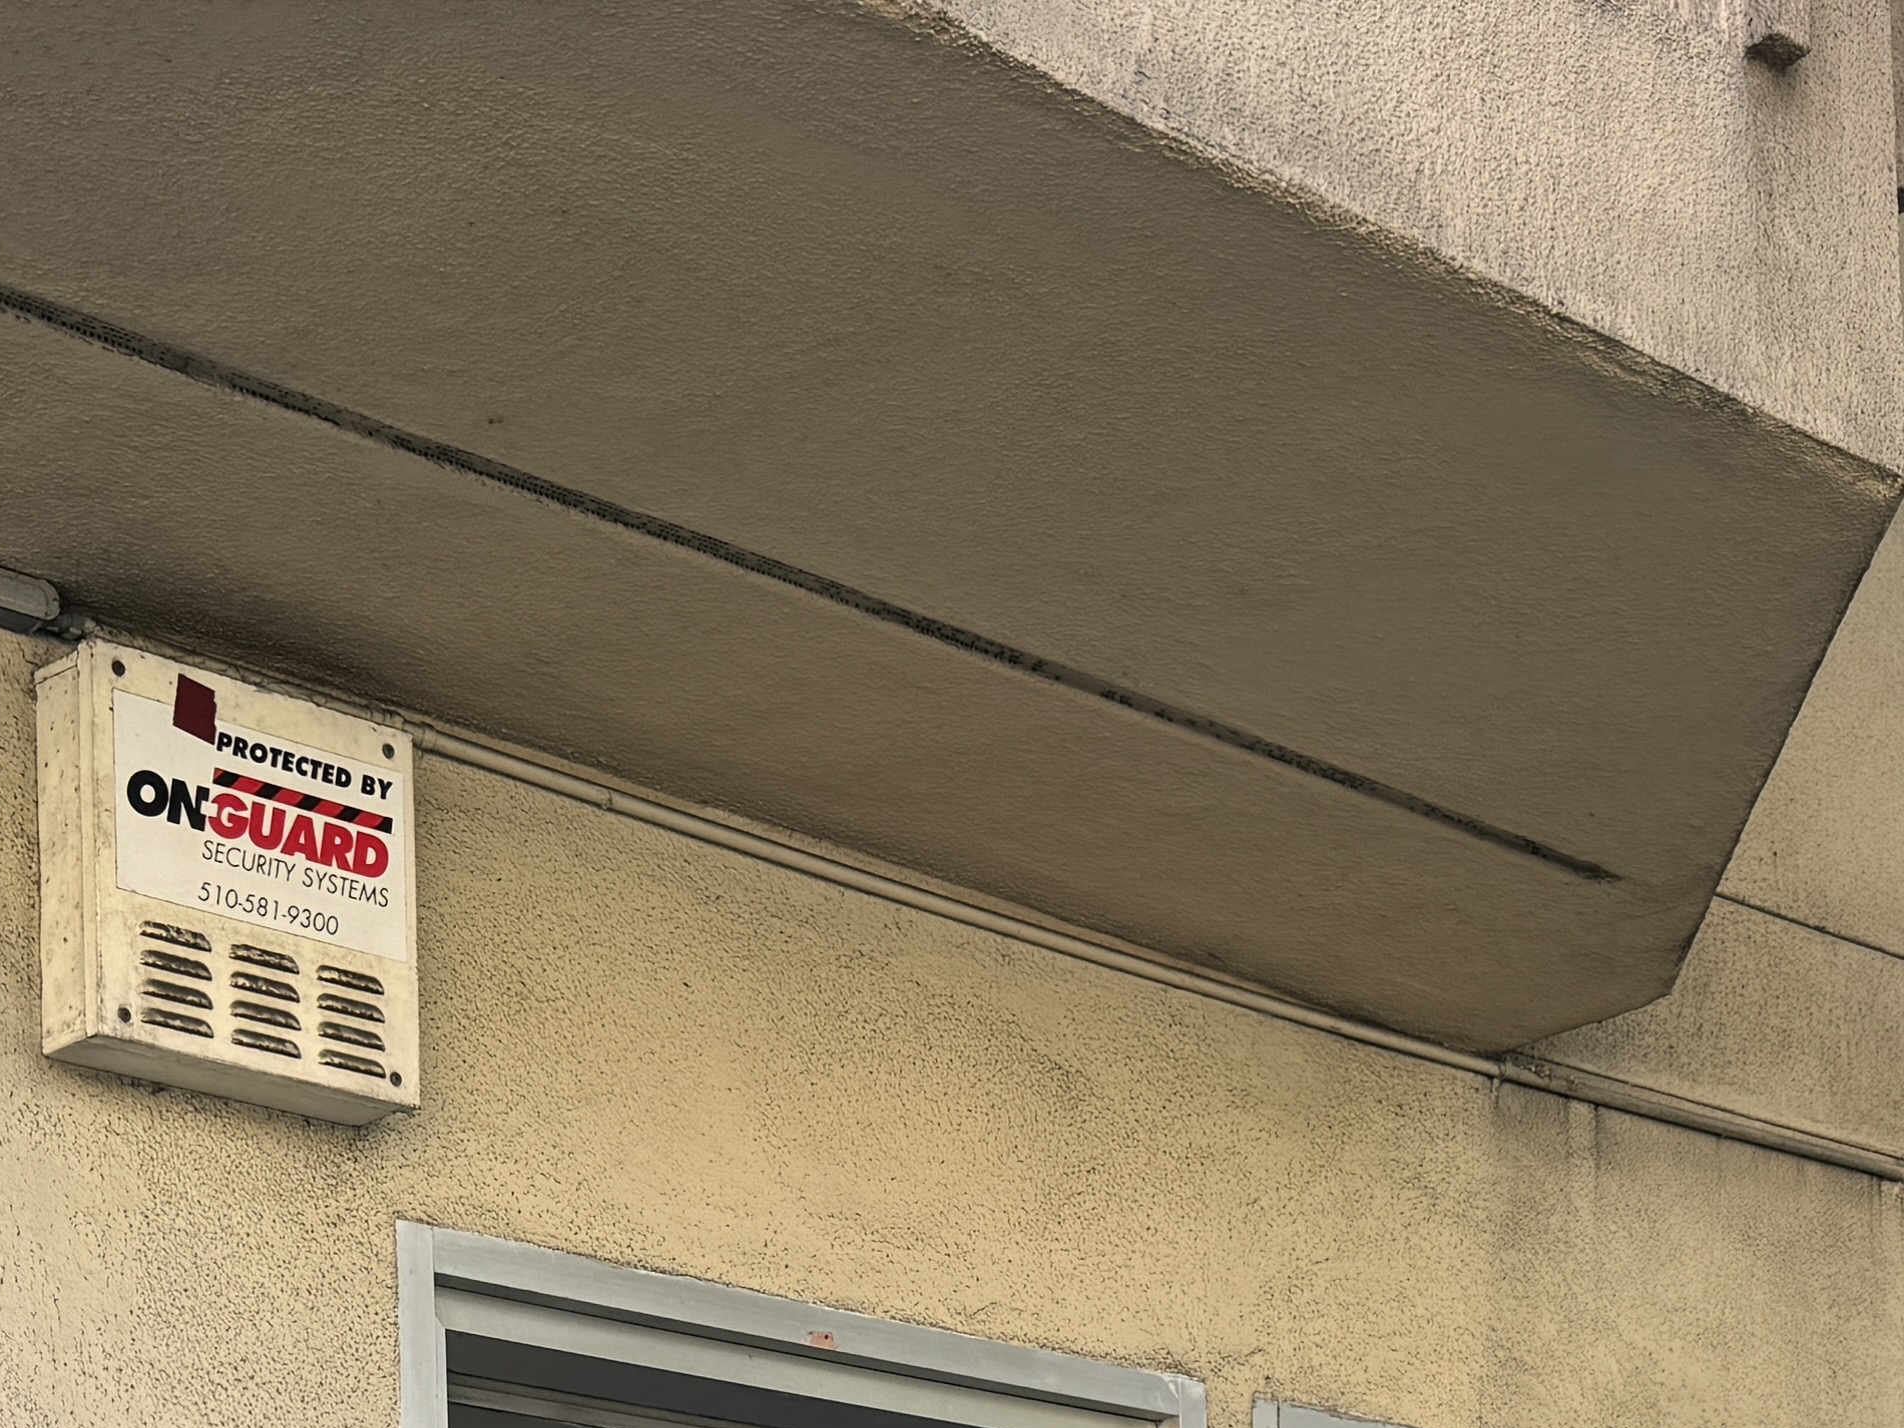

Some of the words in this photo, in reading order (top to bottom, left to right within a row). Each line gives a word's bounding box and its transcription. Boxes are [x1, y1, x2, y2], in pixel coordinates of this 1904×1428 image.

[216, 732, 352, 788] PROTECTED
[360, 774, 393, 800] BY
[202, 840, 296, 882] SECURITY
[303, 868, 389, 908] SYSTEMS
[198, 882, 339, 935] 510-581-9300
